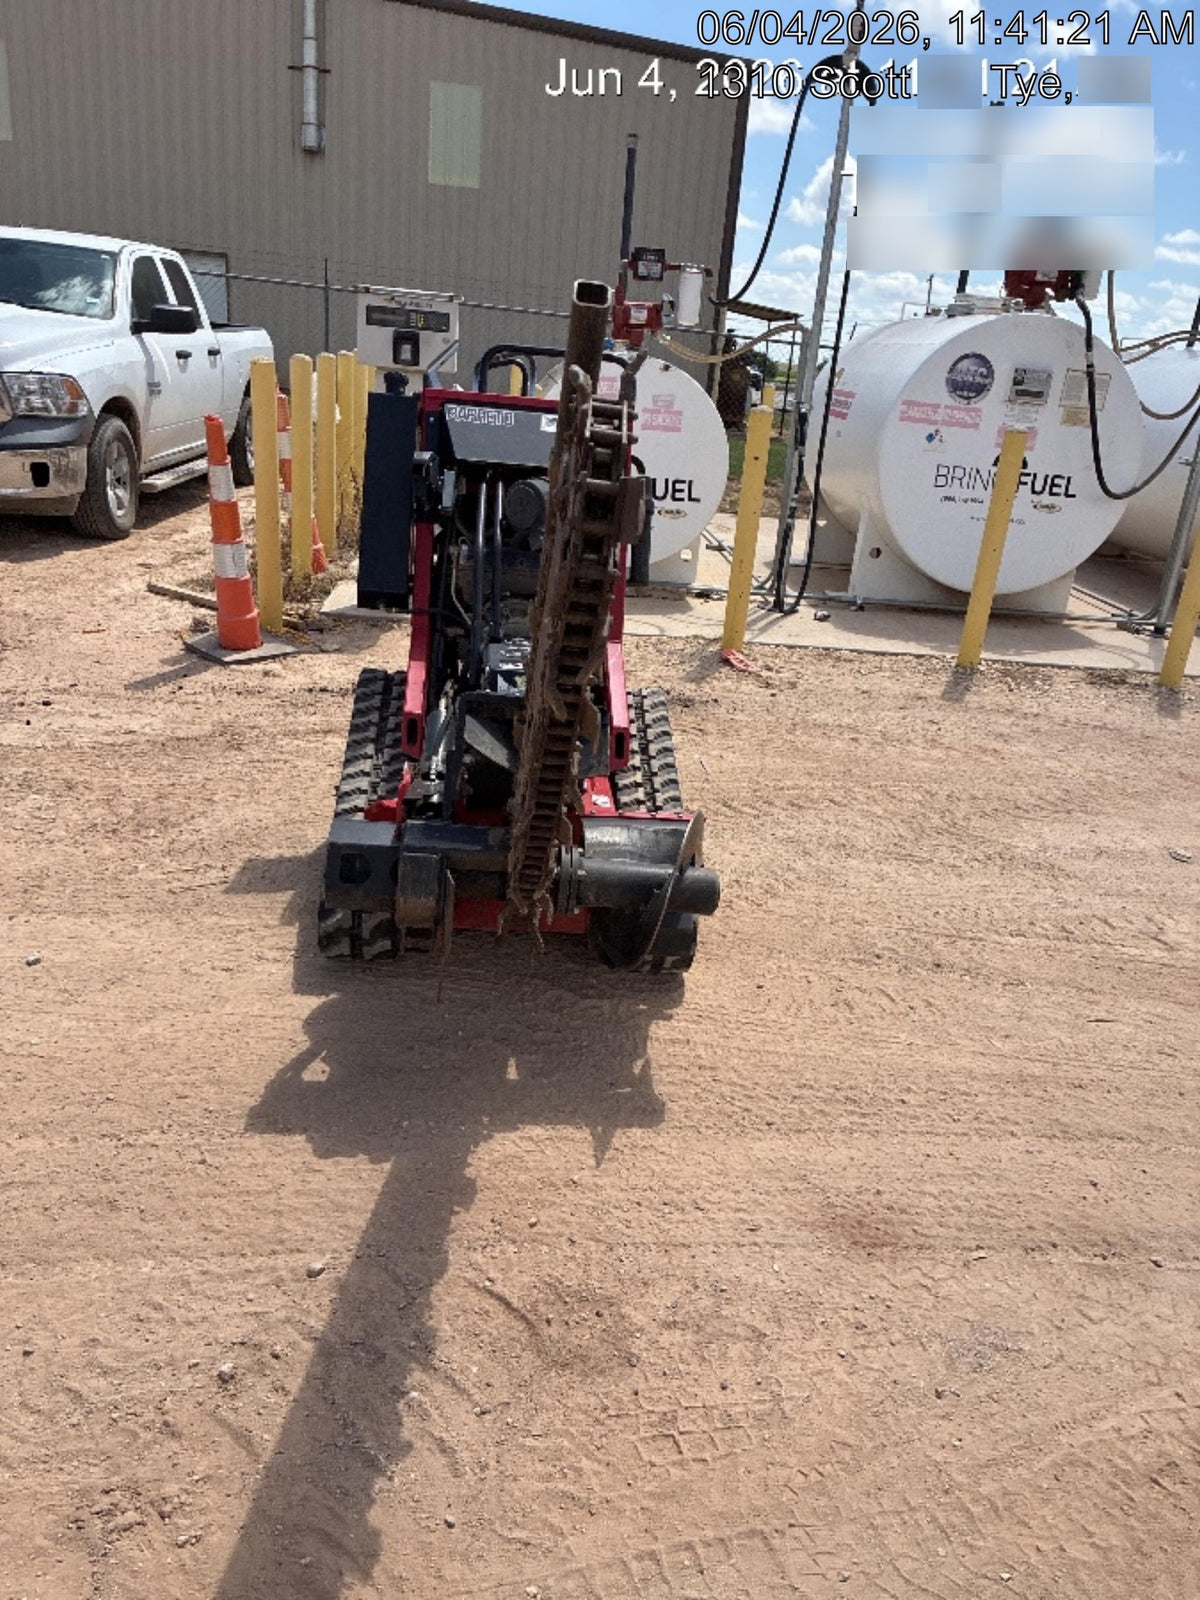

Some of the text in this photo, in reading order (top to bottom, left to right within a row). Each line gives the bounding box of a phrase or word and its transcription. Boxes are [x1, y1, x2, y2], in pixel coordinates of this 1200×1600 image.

[652, 477, 702, 503] UEL
[934, 463, 1077, 499] BRIN FUEL
